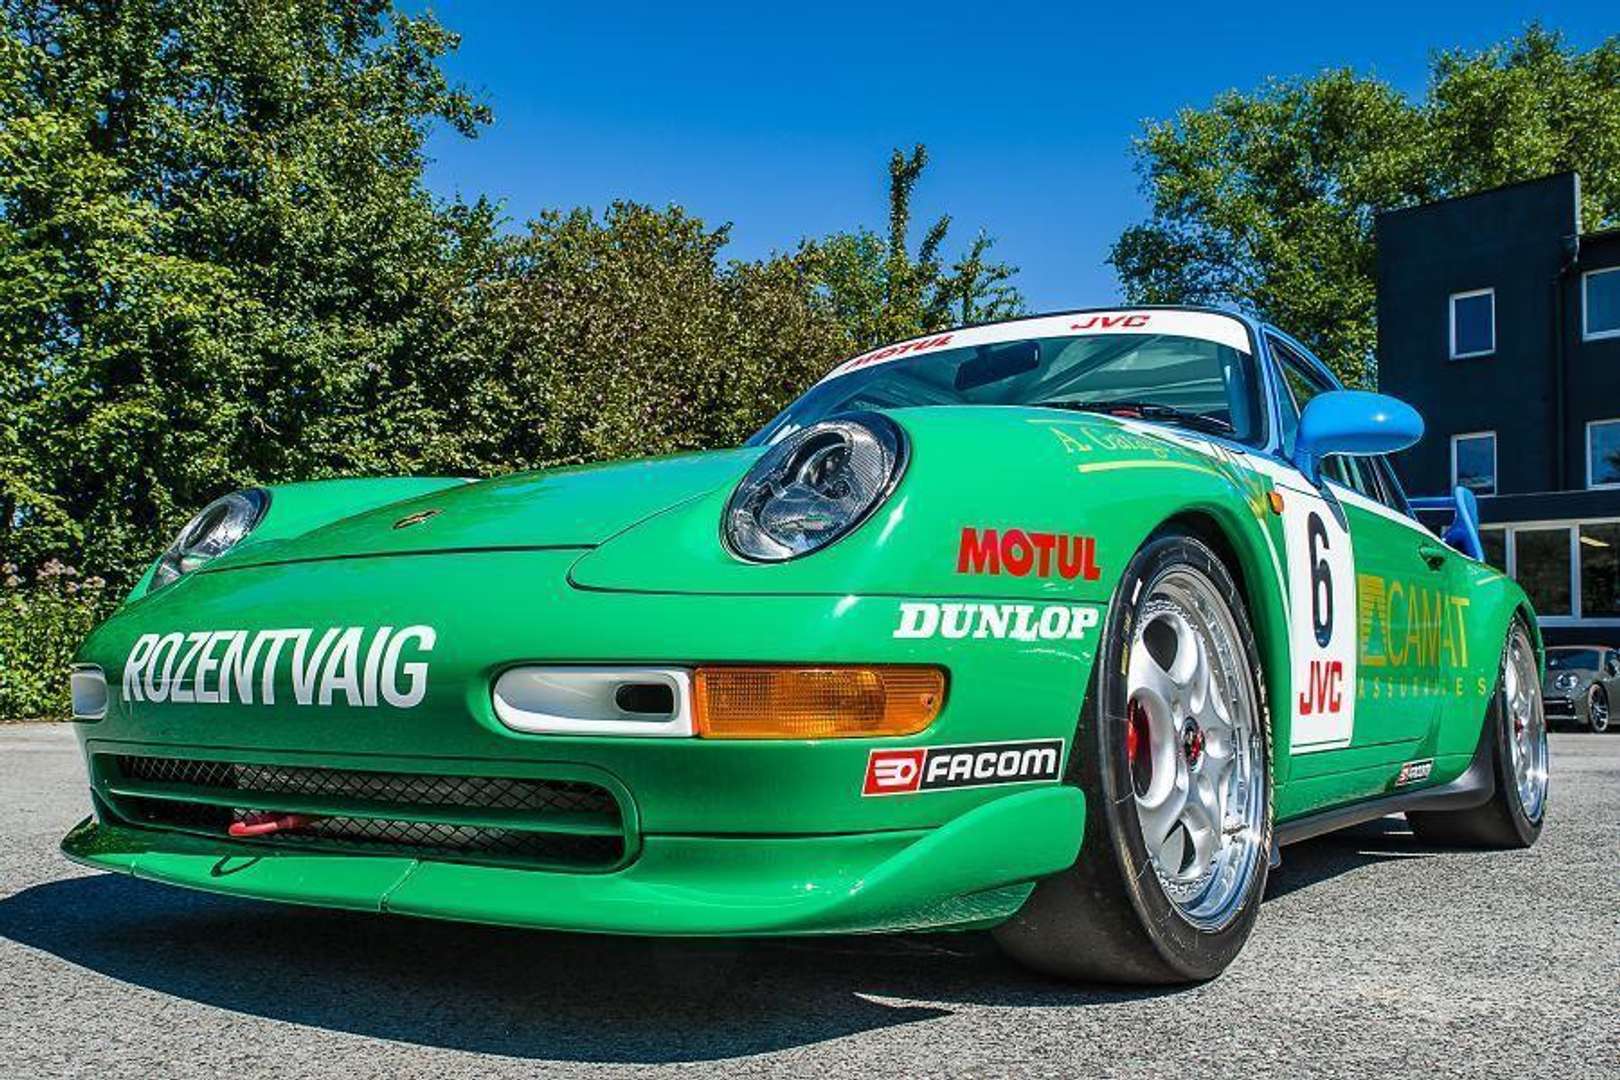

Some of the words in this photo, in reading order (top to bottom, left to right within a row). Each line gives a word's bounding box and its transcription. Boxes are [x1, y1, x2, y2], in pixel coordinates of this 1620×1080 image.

[1070, 314, 1152, 330] JVC
[957, 527, 1101, 581] MOTUL
[1306, 511, 1334, 649] 6
[893, 602, 1099, 641] DUNLOP
[121, 624, 437, 709] ROZENTVAIG
[1299, 660, 1344, 716] JVC
[926, 747, 1055, 783] FACOM
